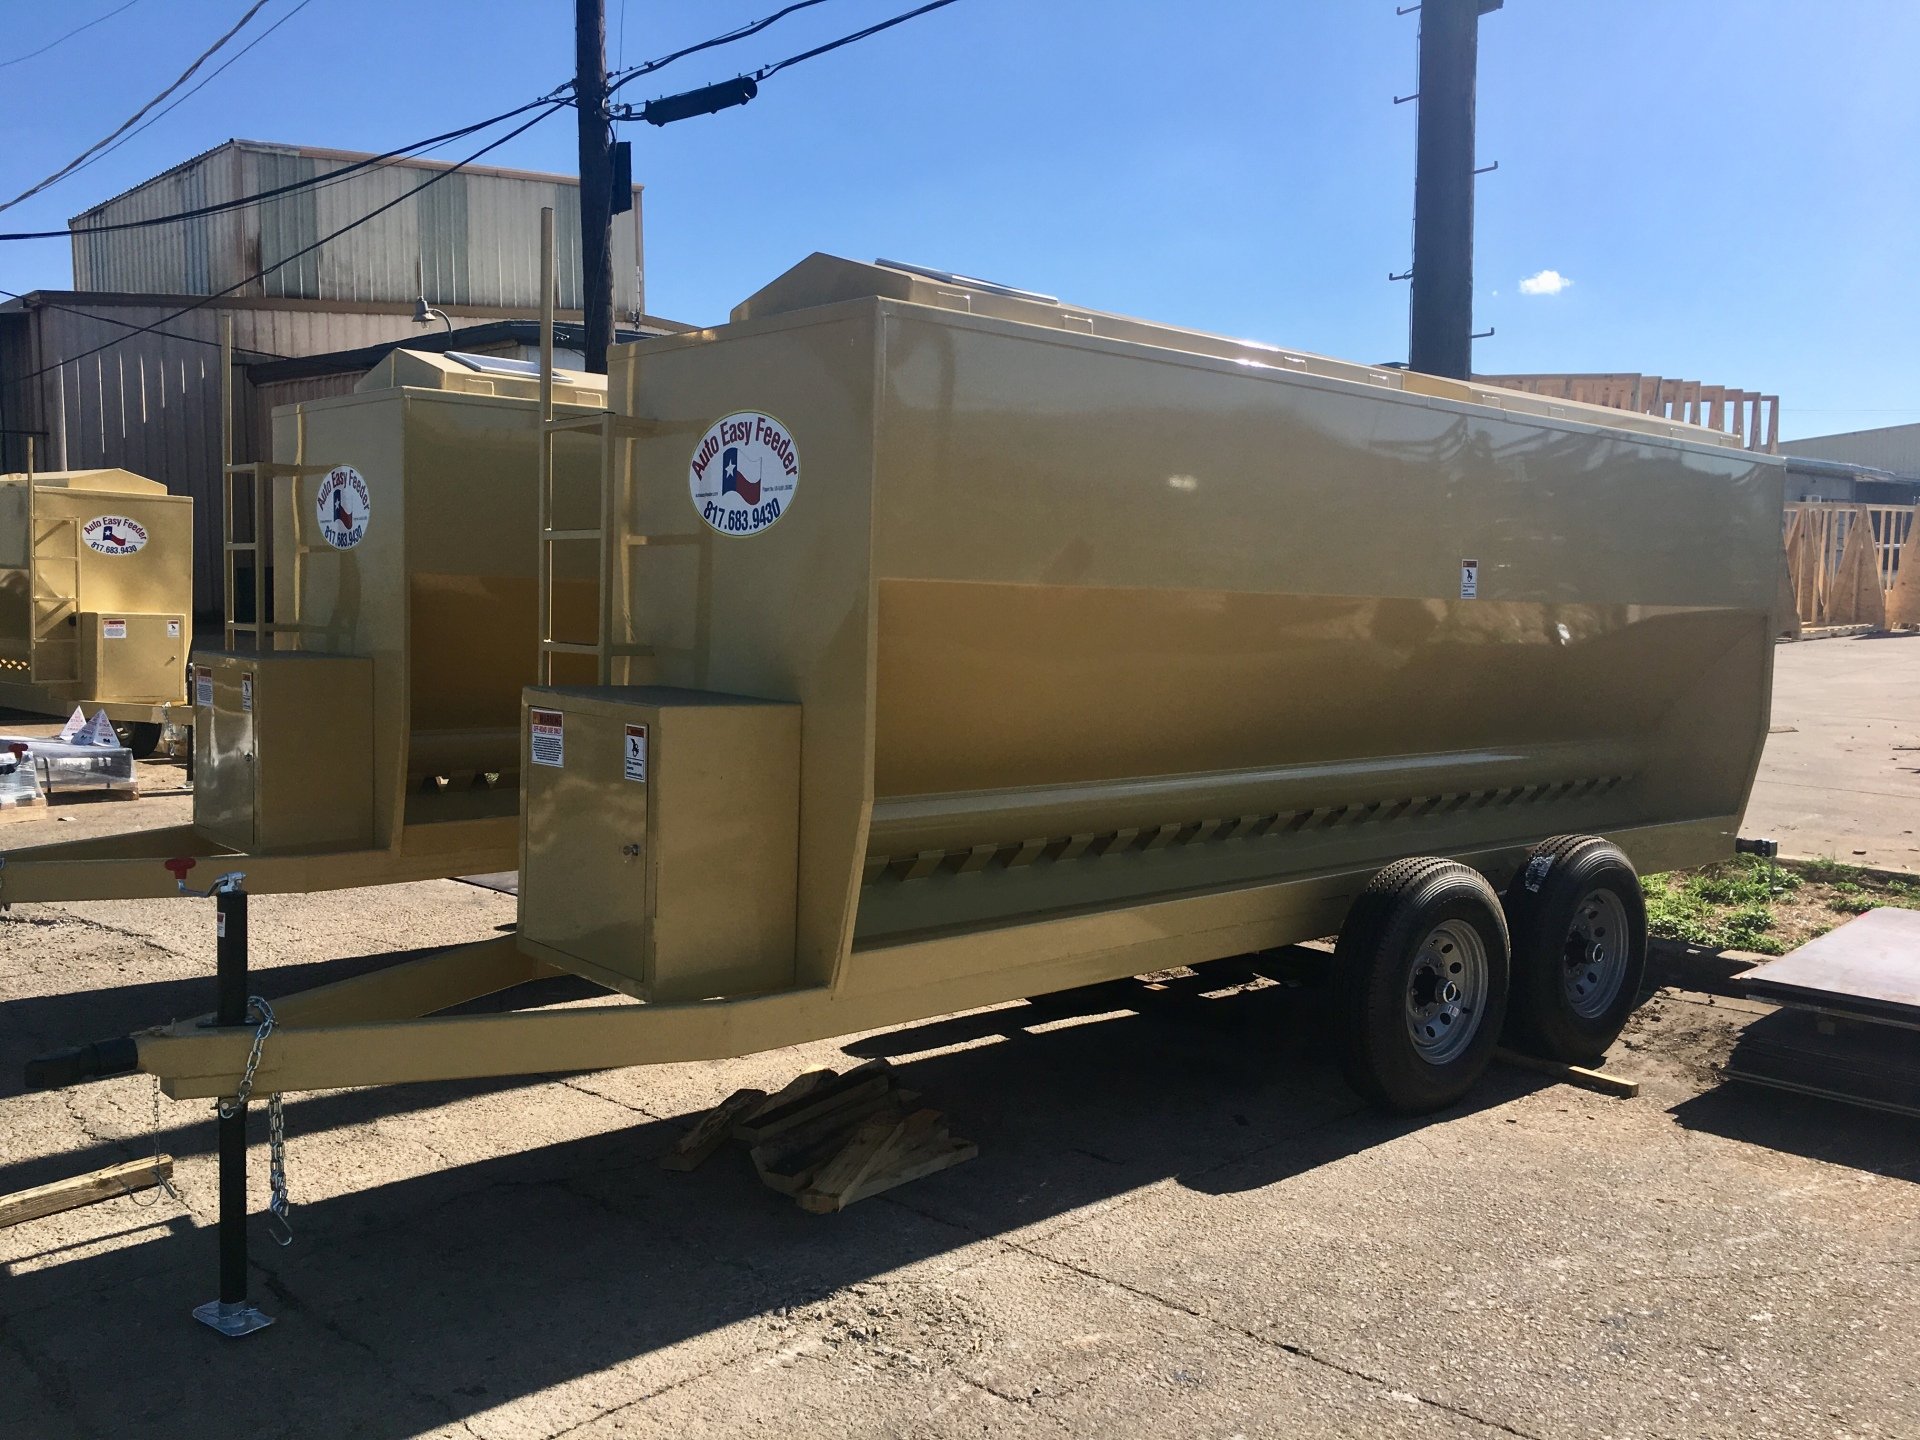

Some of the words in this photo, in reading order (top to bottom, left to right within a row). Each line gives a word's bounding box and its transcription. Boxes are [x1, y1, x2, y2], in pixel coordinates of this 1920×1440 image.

[691, 435, 720, 482] Auto
[719, 420, 753, 447] Easy
[755, 416, 798, 477] Feeder
[317, 480, 332, 512] Auto
[331, 470, 348, 489] Easy
[348, 469, 370, 511] Feeder
[83, 520, 102, 535] Auto
[102, 516, 122, 527] Easy
[123, 518, 147, 540] Feeder
[703, 497, 781, 531] 817.683.9430
[90, 541, 138, 555] 817.683.9430
[324, 524, 363, 547] 817.683.9430
